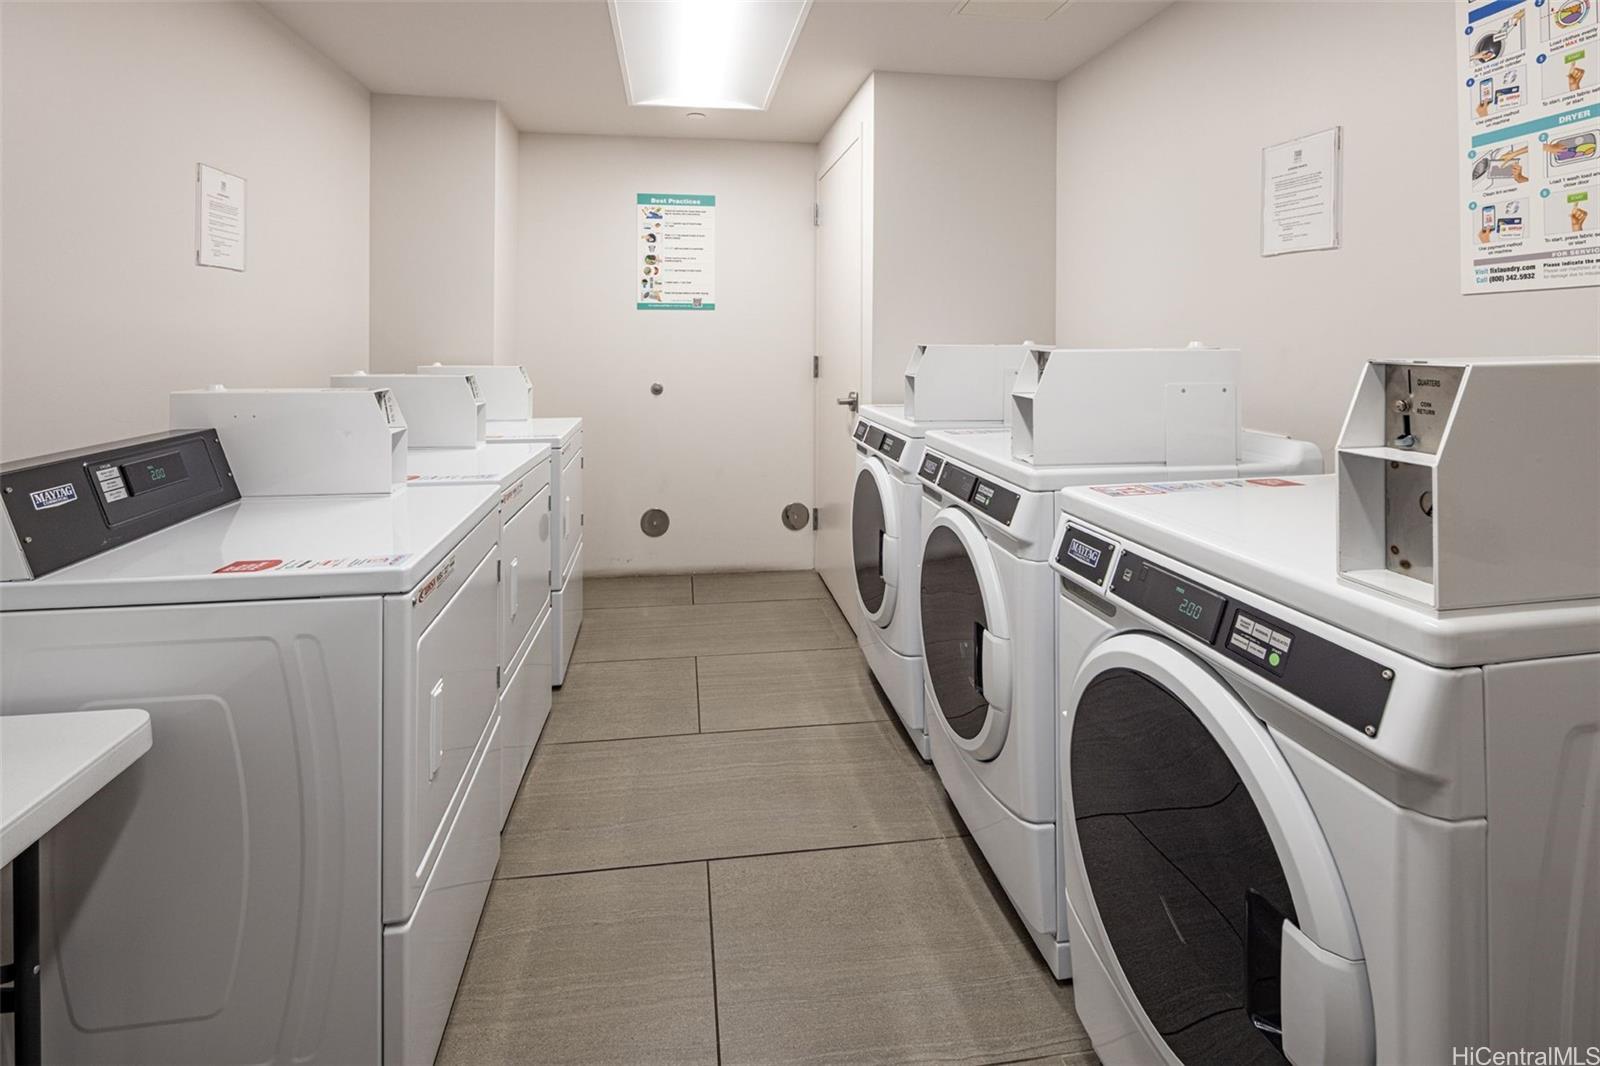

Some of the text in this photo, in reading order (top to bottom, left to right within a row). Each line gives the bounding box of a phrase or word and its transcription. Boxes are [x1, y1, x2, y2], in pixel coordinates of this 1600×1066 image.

[1559, 110, 1591, 124] DRYER
[668, 198, 701, 206] Practices
[1489, 276, 1505, 284] (800)
[1506, 273, 1535, 281] 342.5932
[1417, 379, 1440, 387] QUARTERS
[34, 486, 72, 504] MAYTAG
[1071, 541, 1098, 561] MAYTAG
[1179, 598, 1202, 620] 2.00
